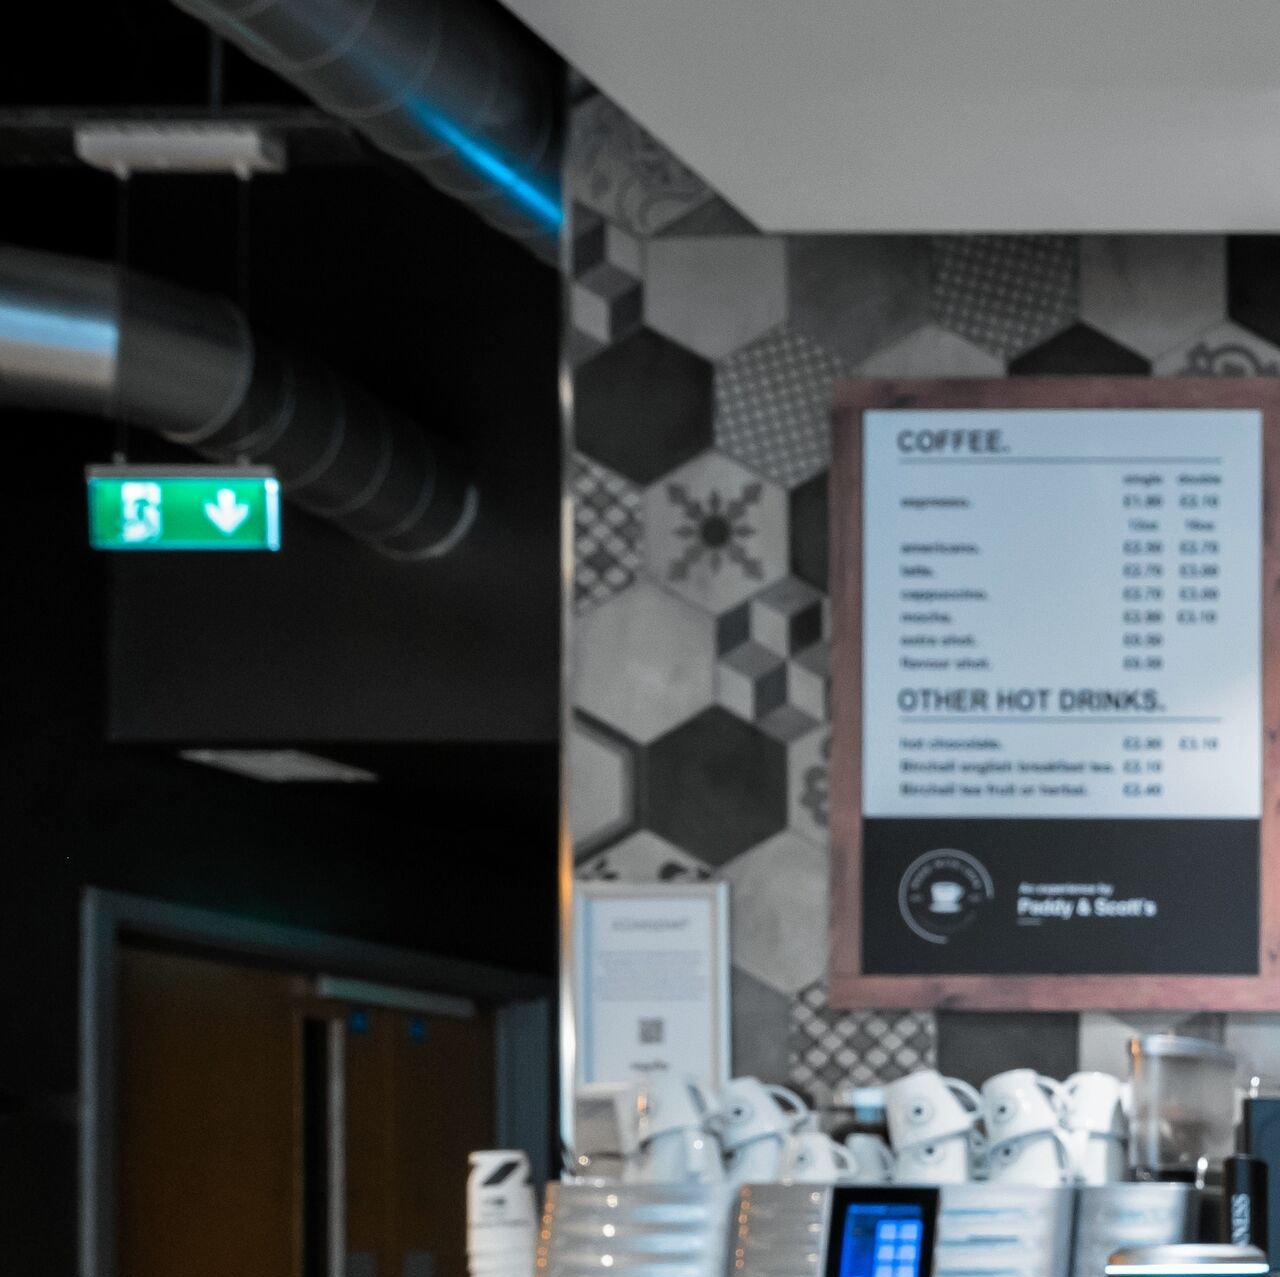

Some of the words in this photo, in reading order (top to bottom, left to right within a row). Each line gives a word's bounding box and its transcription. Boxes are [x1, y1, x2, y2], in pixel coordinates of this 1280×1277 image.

[897, 429, 1010, 454] COFFEE.
[898, 687, 989, 713] OTHER
[996, 687, 1053, 713] HOT
[1058, 687, 1167, 713] DRINKS.
[1017, 897, 1074, 920] Paddy
[1076, 898, 1091, 918] &
